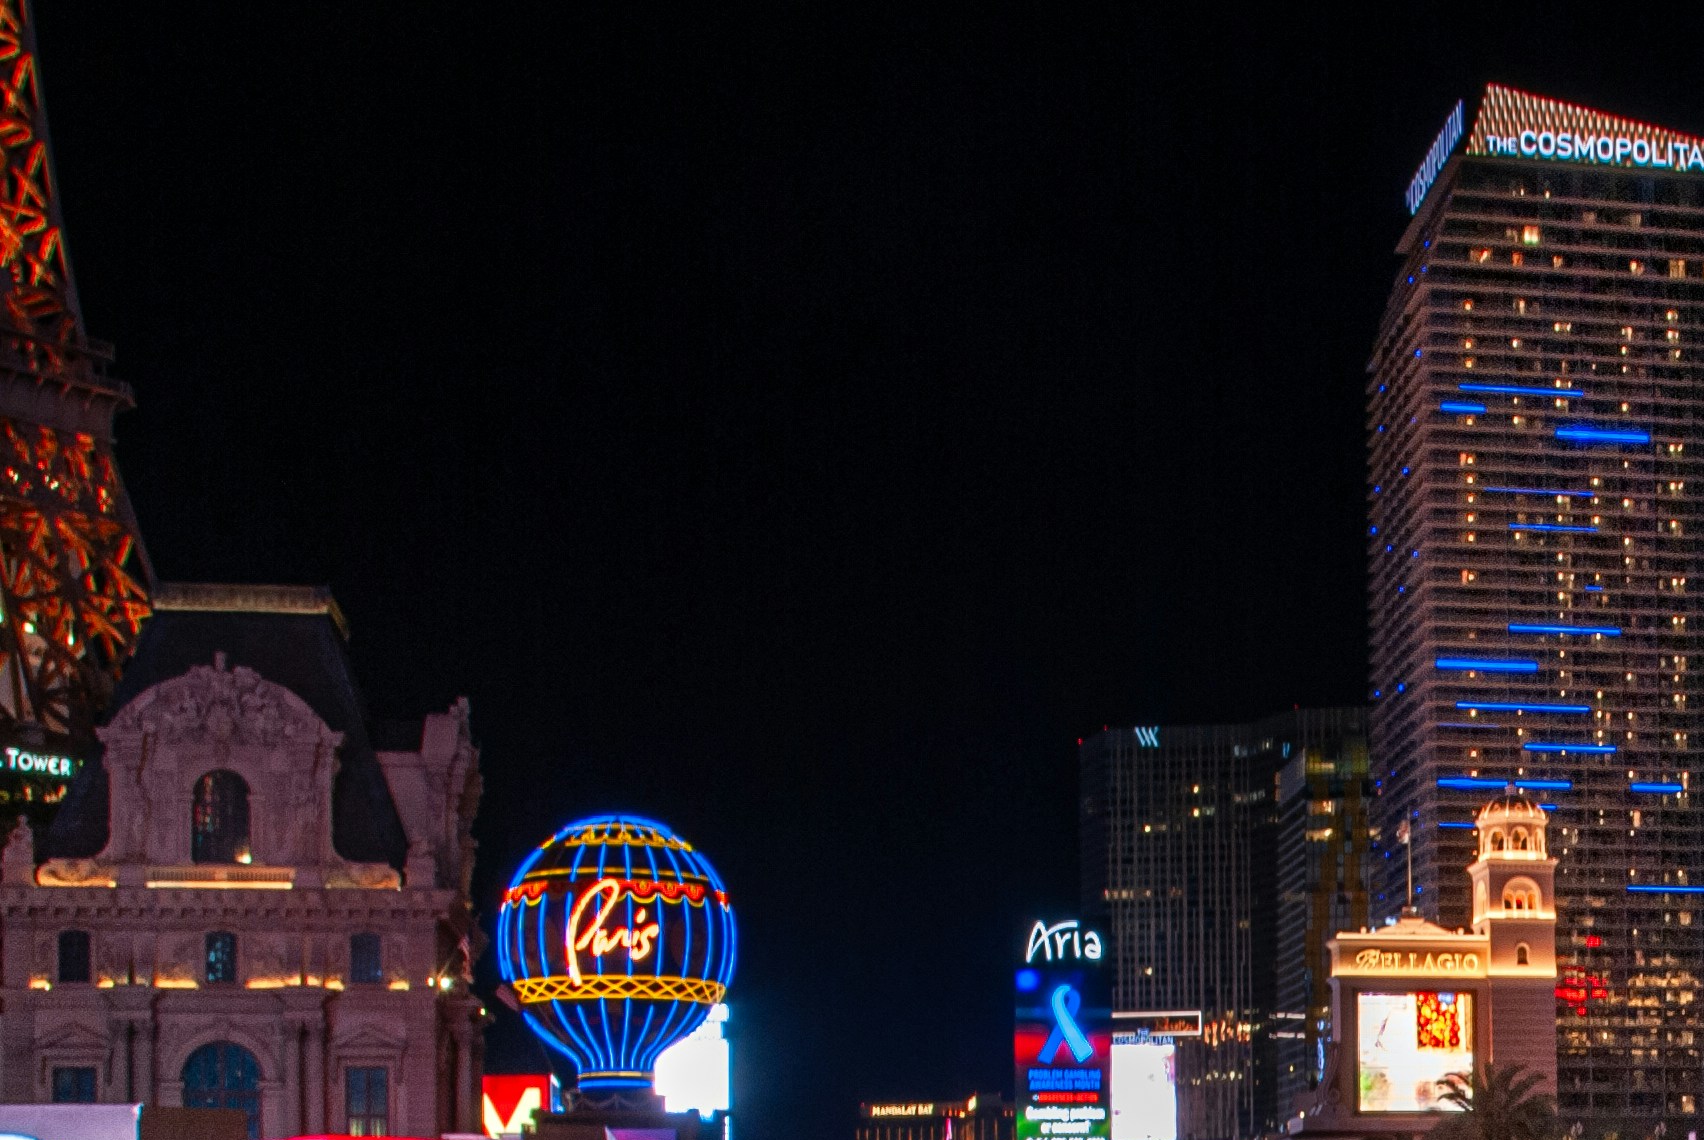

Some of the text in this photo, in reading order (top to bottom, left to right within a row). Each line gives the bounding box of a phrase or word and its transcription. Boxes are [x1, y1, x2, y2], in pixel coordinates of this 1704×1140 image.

[1409, 99, 1464, 217] COSMOPOLITAN
[1486, 134, 1518, 153] THE
[4, 747, 72, 776] TOWER
[565, 877, 660, 987] Paris
[1025, 920, 1102, 963] Aria
[1355, 949, 1479, 972] BELLAGIO
[871, 1102, 934, 1117] MANDALAY BAY
